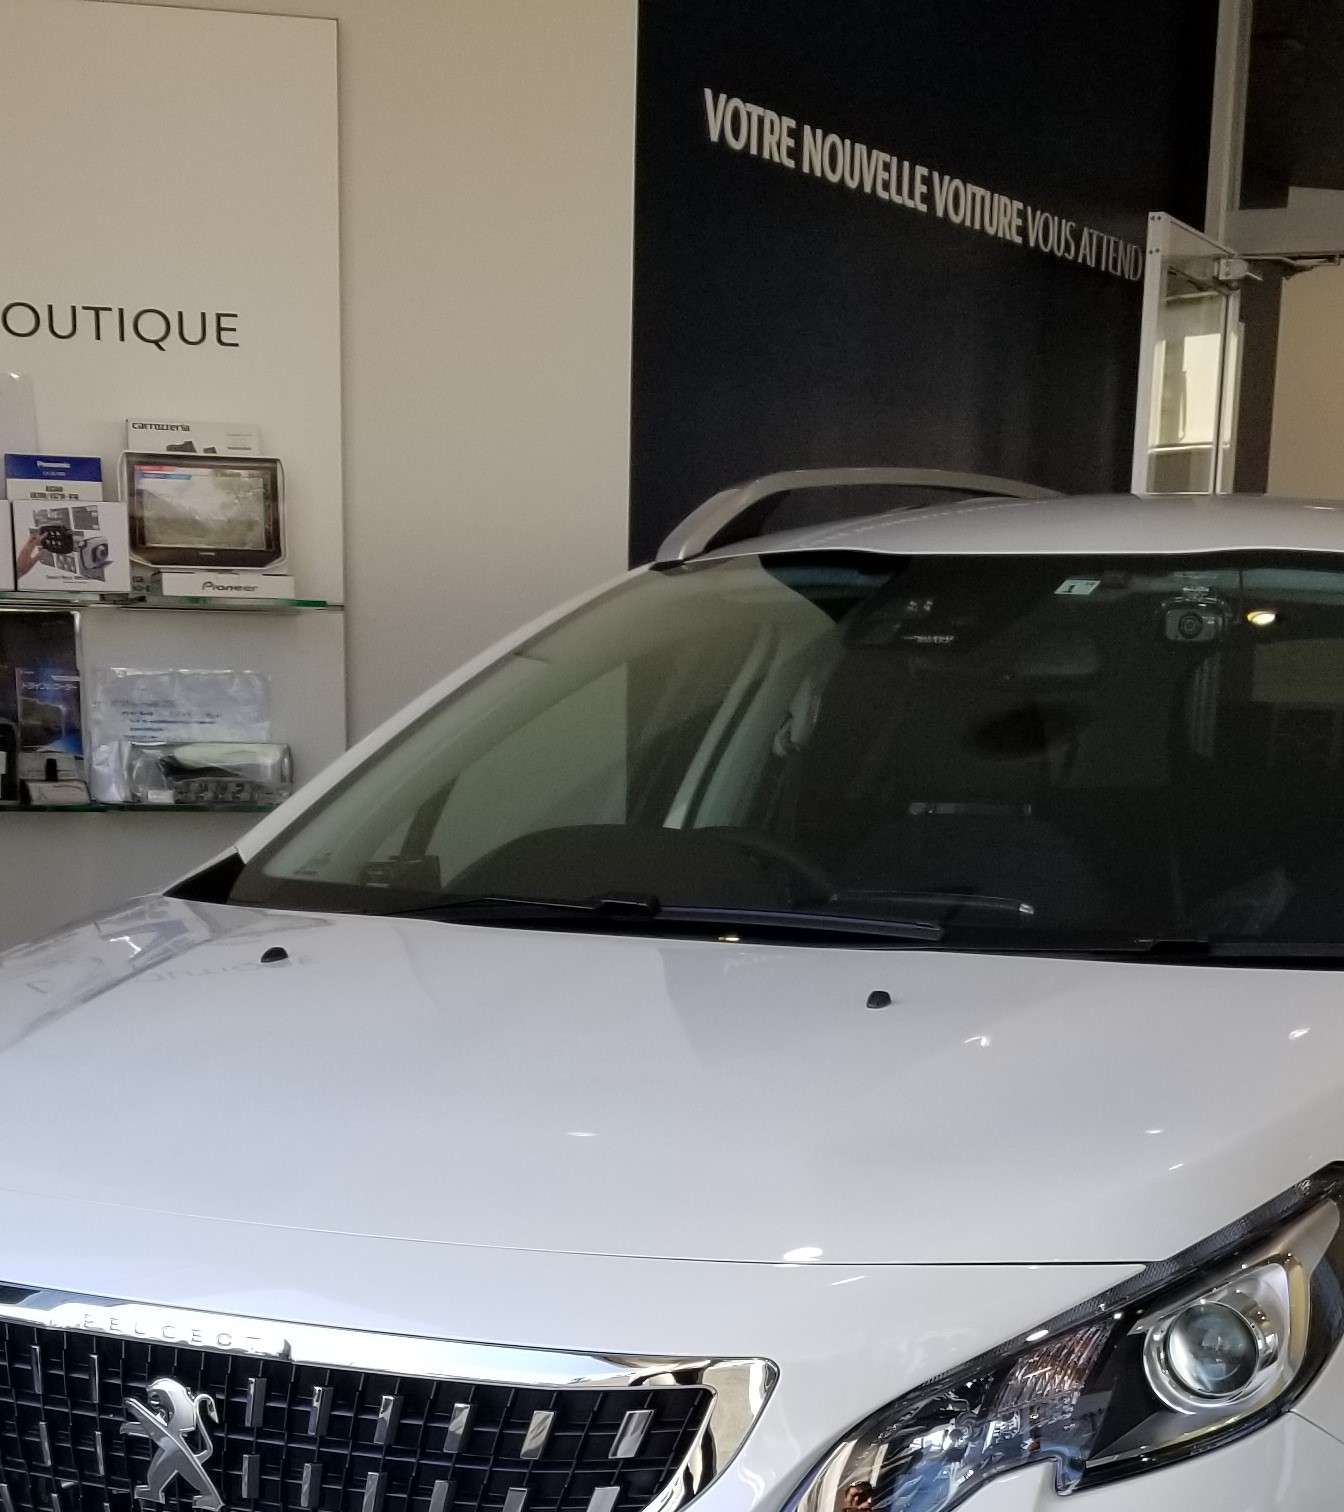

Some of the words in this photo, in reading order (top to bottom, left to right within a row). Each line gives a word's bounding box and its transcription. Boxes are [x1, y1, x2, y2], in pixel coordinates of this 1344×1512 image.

[704, 88, 796, 169] VOTRE
[802, 124, 928, 212] NOUVELLE
[932, 170, 1024, 244] VOITURE
[1027, 205, 1076, 261] VOUS
[1078, 226, 1143, 281] ATTEND
[201, 581, 259, 592] Pioneer
